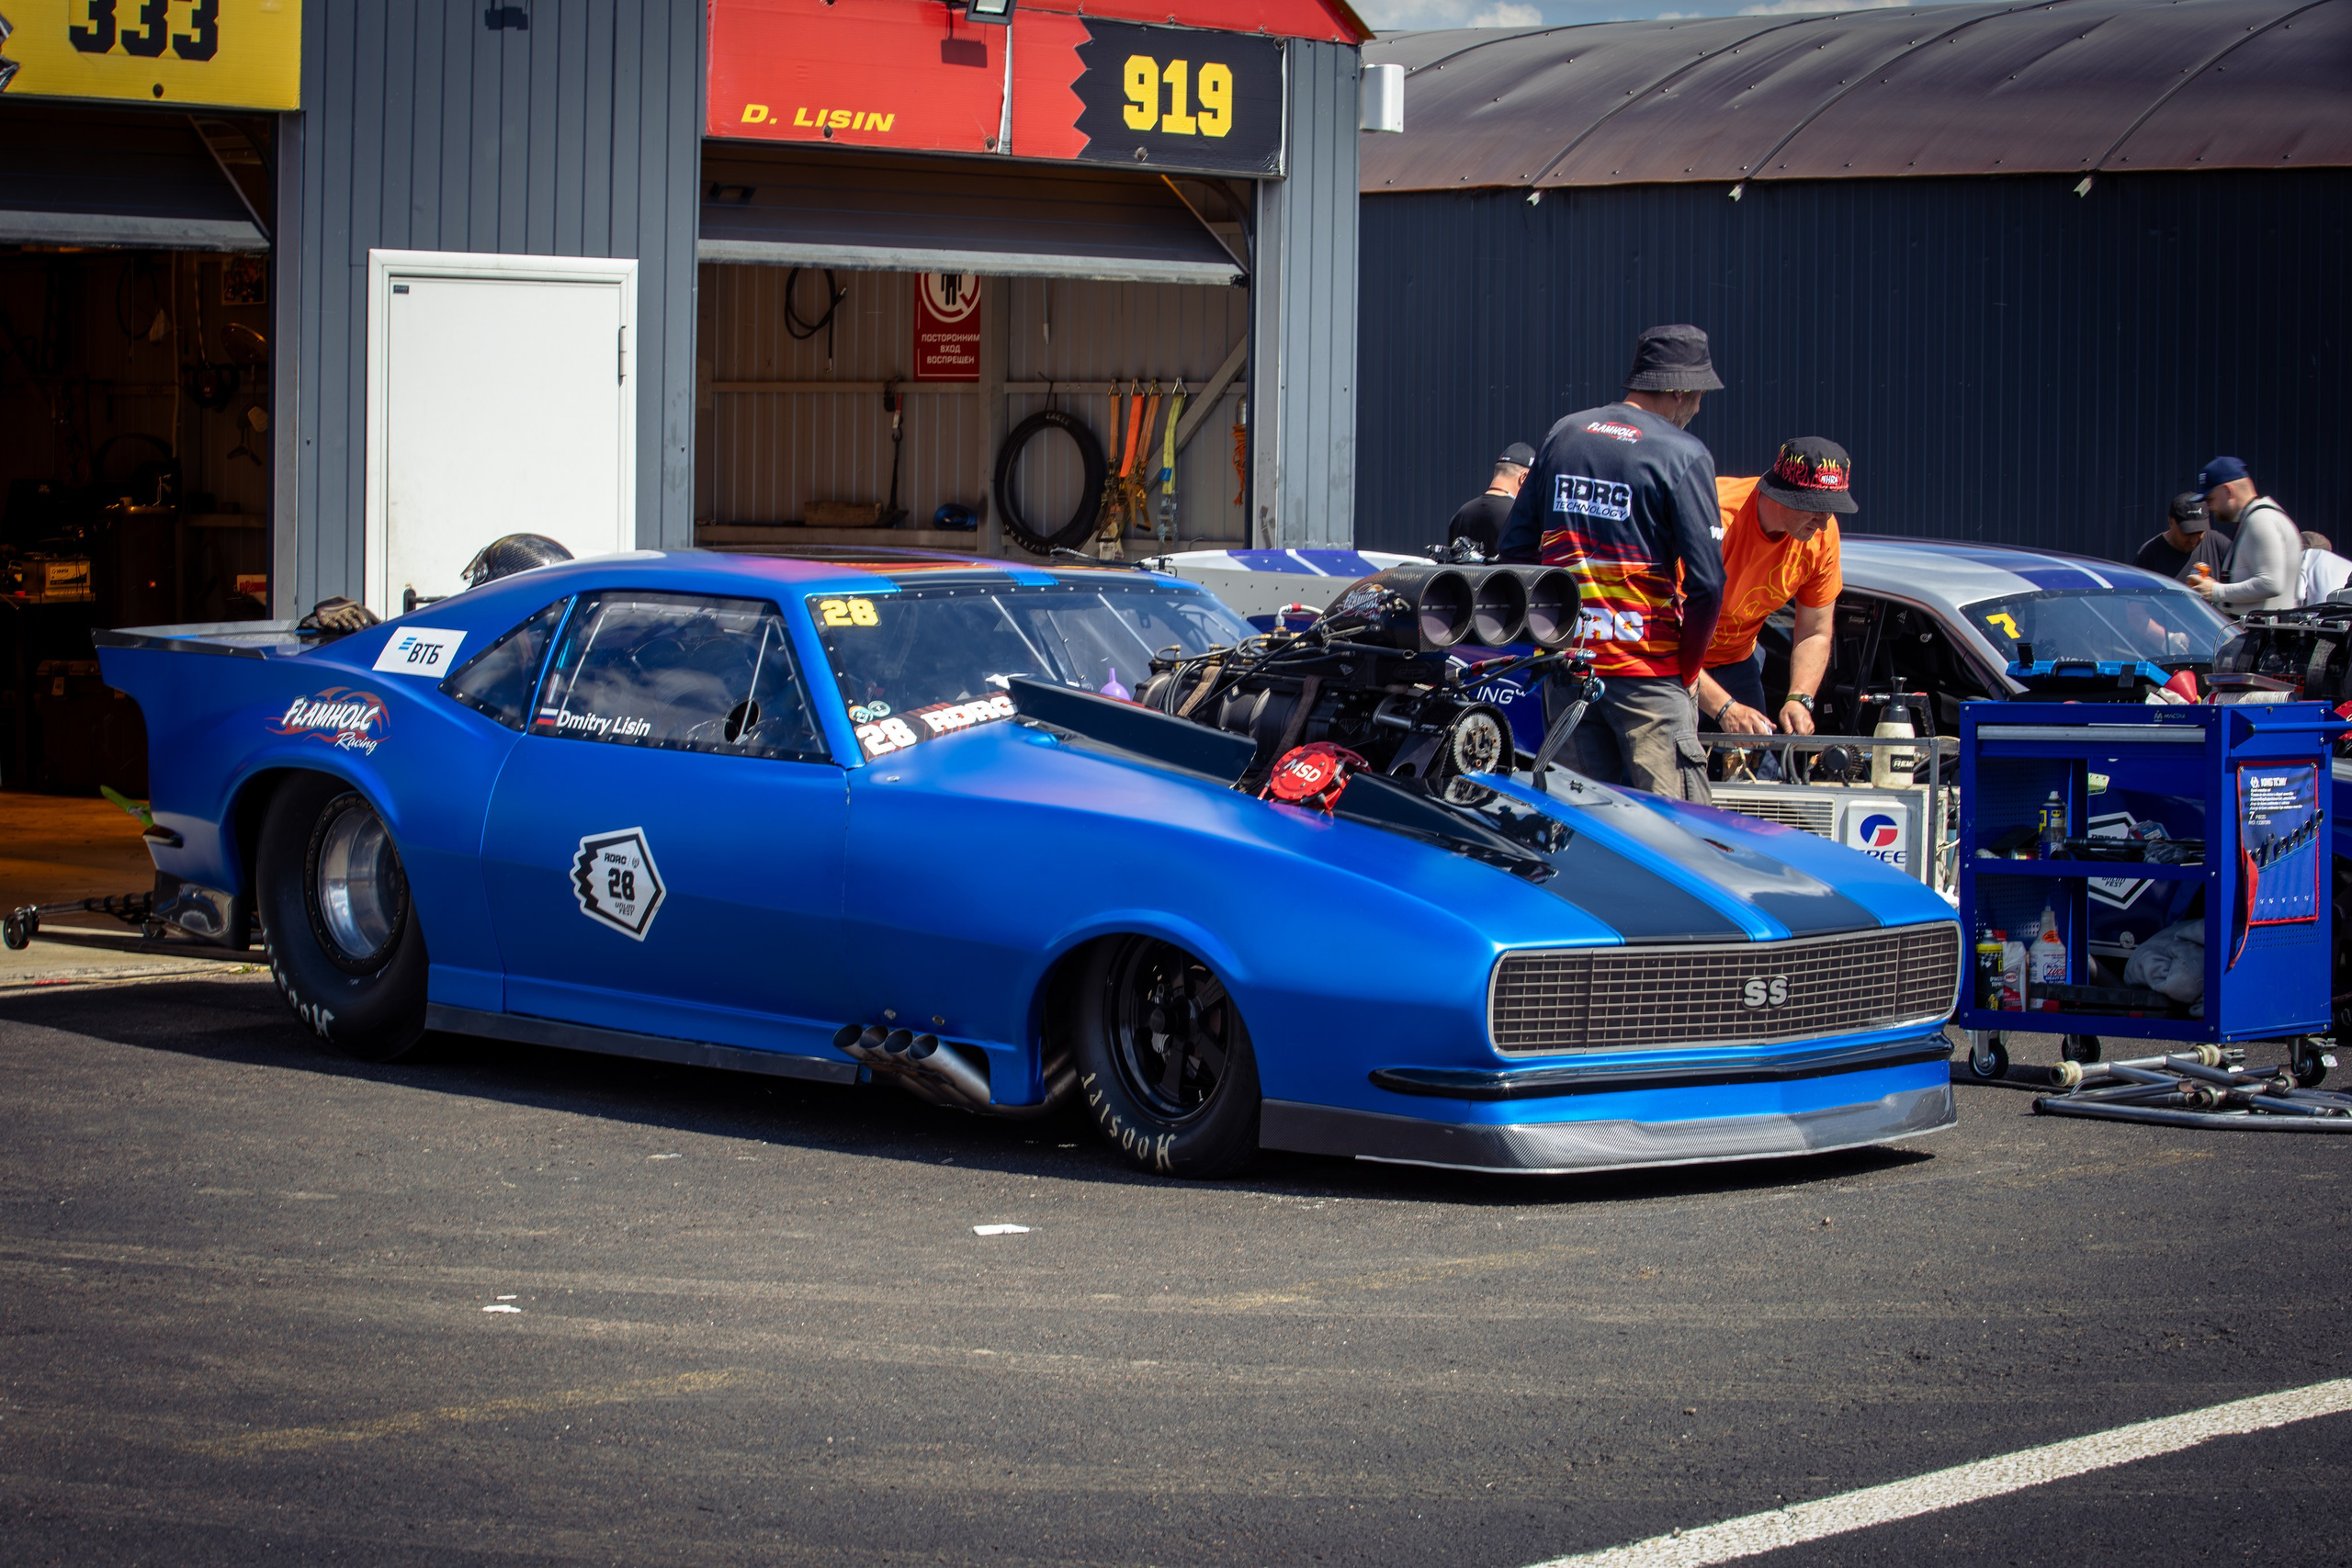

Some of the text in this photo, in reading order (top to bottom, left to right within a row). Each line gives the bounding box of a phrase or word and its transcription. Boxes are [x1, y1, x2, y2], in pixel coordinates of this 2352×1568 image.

[69, 0, 220, 62] 333
[1123, 54, 1233, 138] 919
[741, 103, 895, 132] D. LISIN
[921, 333, 980, 343] ПОСТОРОННИМ
[940, 344, 961, 354] ВХОД
[926, 355, 975, 365] ВОСПРЕЩЕН
[1557, 478, 1630, 508] RDRC
[1555, 501, 1627, 519] TECHNOLOGY
[820, 599, 879, 626] 28
[1574, 607, 1644, 642] RC
[1985, 613, 2021, 639] 7
[406, 642, 445, 665] ВТБ
[556, 709, 651, 738] Dmitry Lisin
[855, 695, 1019, 756] 28 RDRC
[334, 731, 378, 756] Racing
[1283, 758, 1322, 783] MSD
[605, 852, 627, 864] RDRC
[1859, 850, 1908, 864] REE
[608, 867, 635, 901] 28
[618, 908, 633, 917] FEST
[1743, 976, 1789, 1010] SS
